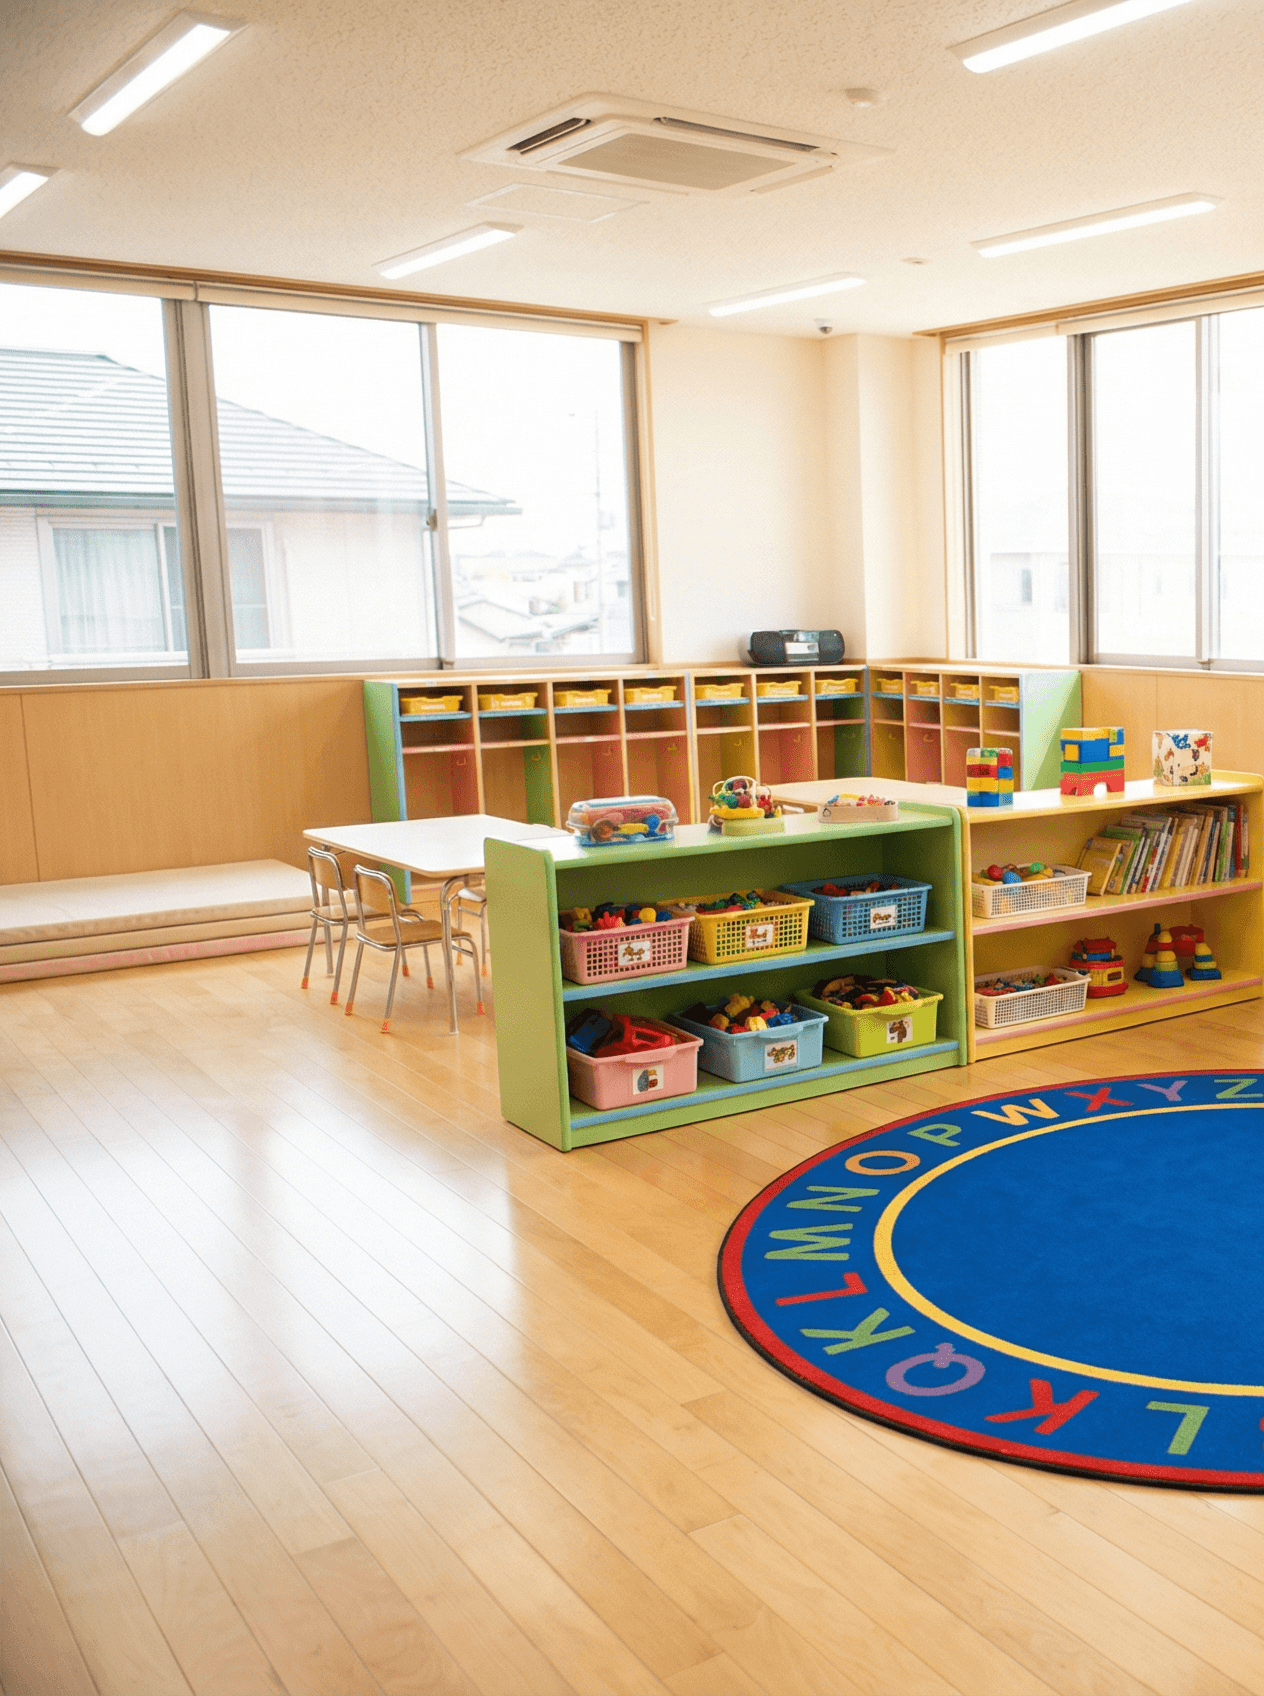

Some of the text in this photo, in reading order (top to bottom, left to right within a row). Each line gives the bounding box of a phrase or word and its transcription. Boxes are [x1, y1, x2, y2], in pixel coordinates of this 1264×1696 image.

[1064, 1086, 1134, 1112] X
[1136, 1080, 1188, 1102] Y
[1213, 1078, 1264, 1100] Z
[971, 1097, 1060, 1126] W
[907, 1122, 962, 1147] P
[844, 1149, 921, 1176] O
[787, 1185, 880, 1212] N
[775, 1271, 868, 1307] L
[800, 1307, 915, 1355] K
[886, 1343, 985, 1396] Q
[984, 1378, 1100, 1435] K
[1145, 1400, 1210, 1456] L
